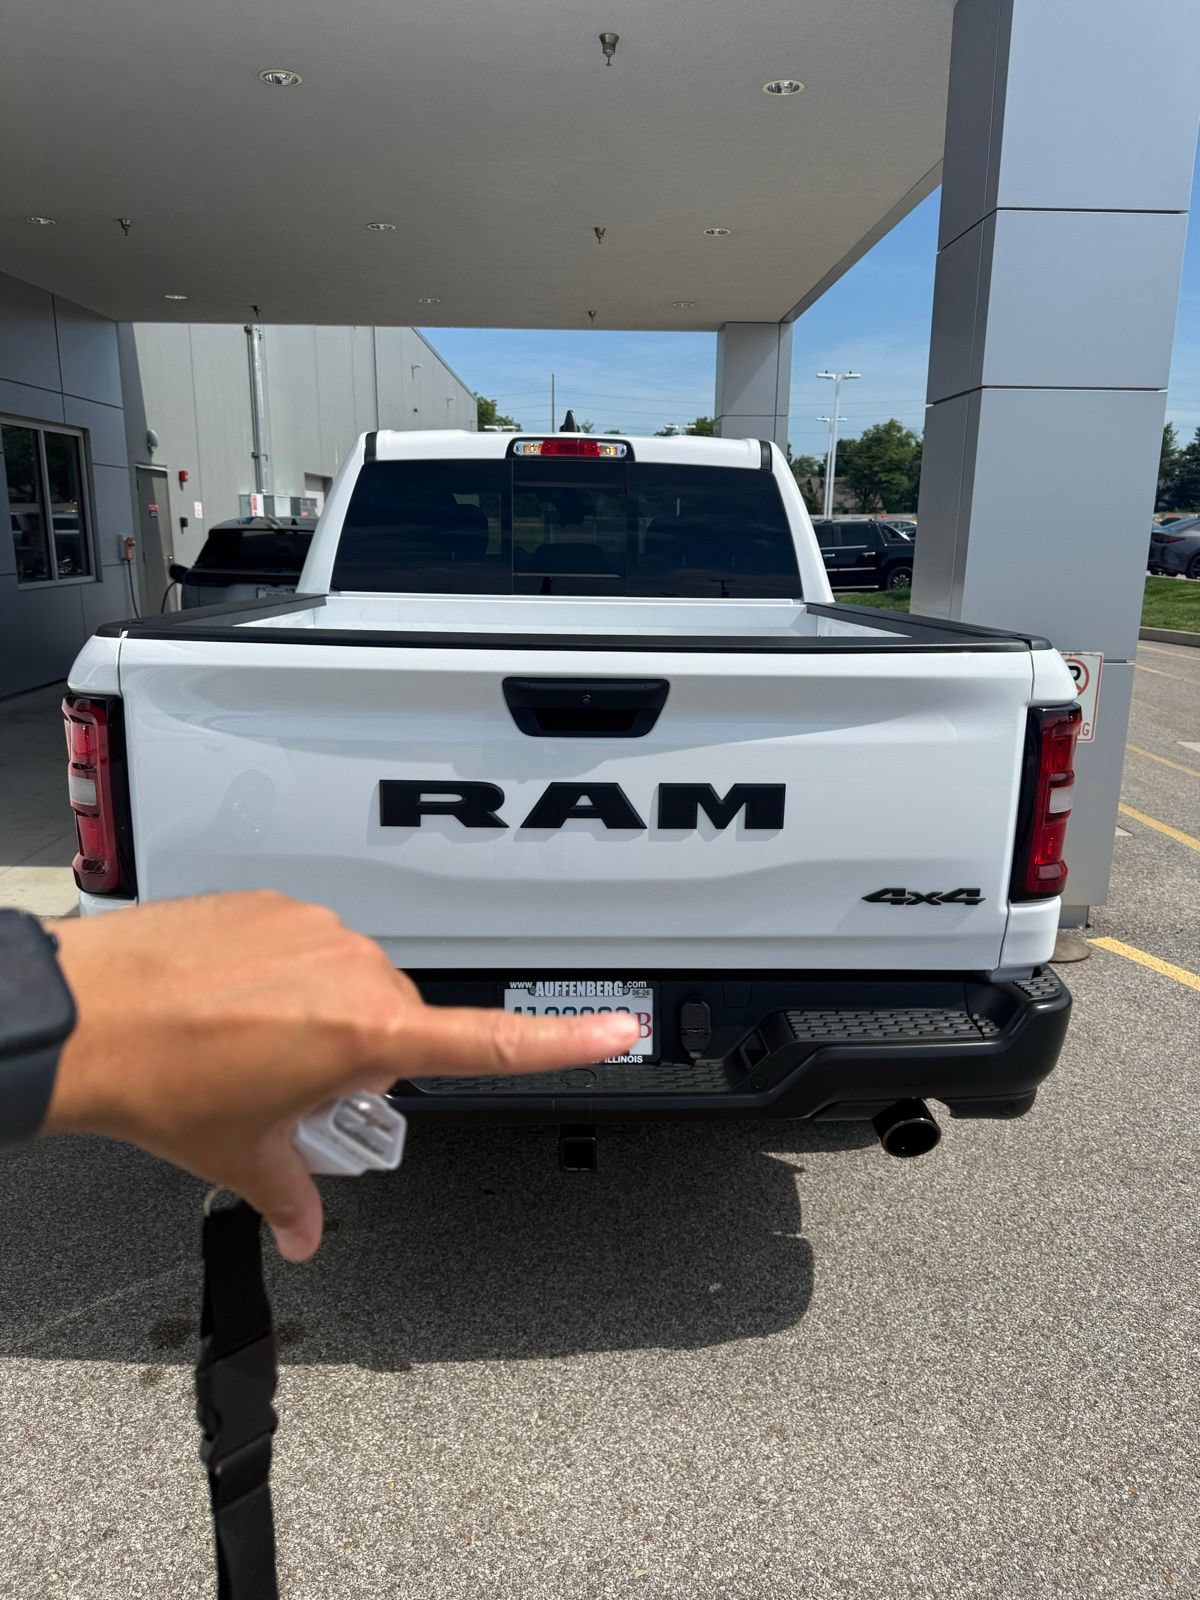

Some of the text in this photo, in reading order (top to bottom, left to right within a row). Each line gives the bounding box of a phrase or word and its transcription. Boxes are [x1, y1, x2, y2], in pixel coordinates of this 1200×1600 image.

[379, 779, 787, 829] RAM
[861, 888, 986, 905] 4x4
[635, 1012, 653, 1038] B
[604, 1055, 643, 1064] ILLINOIS
